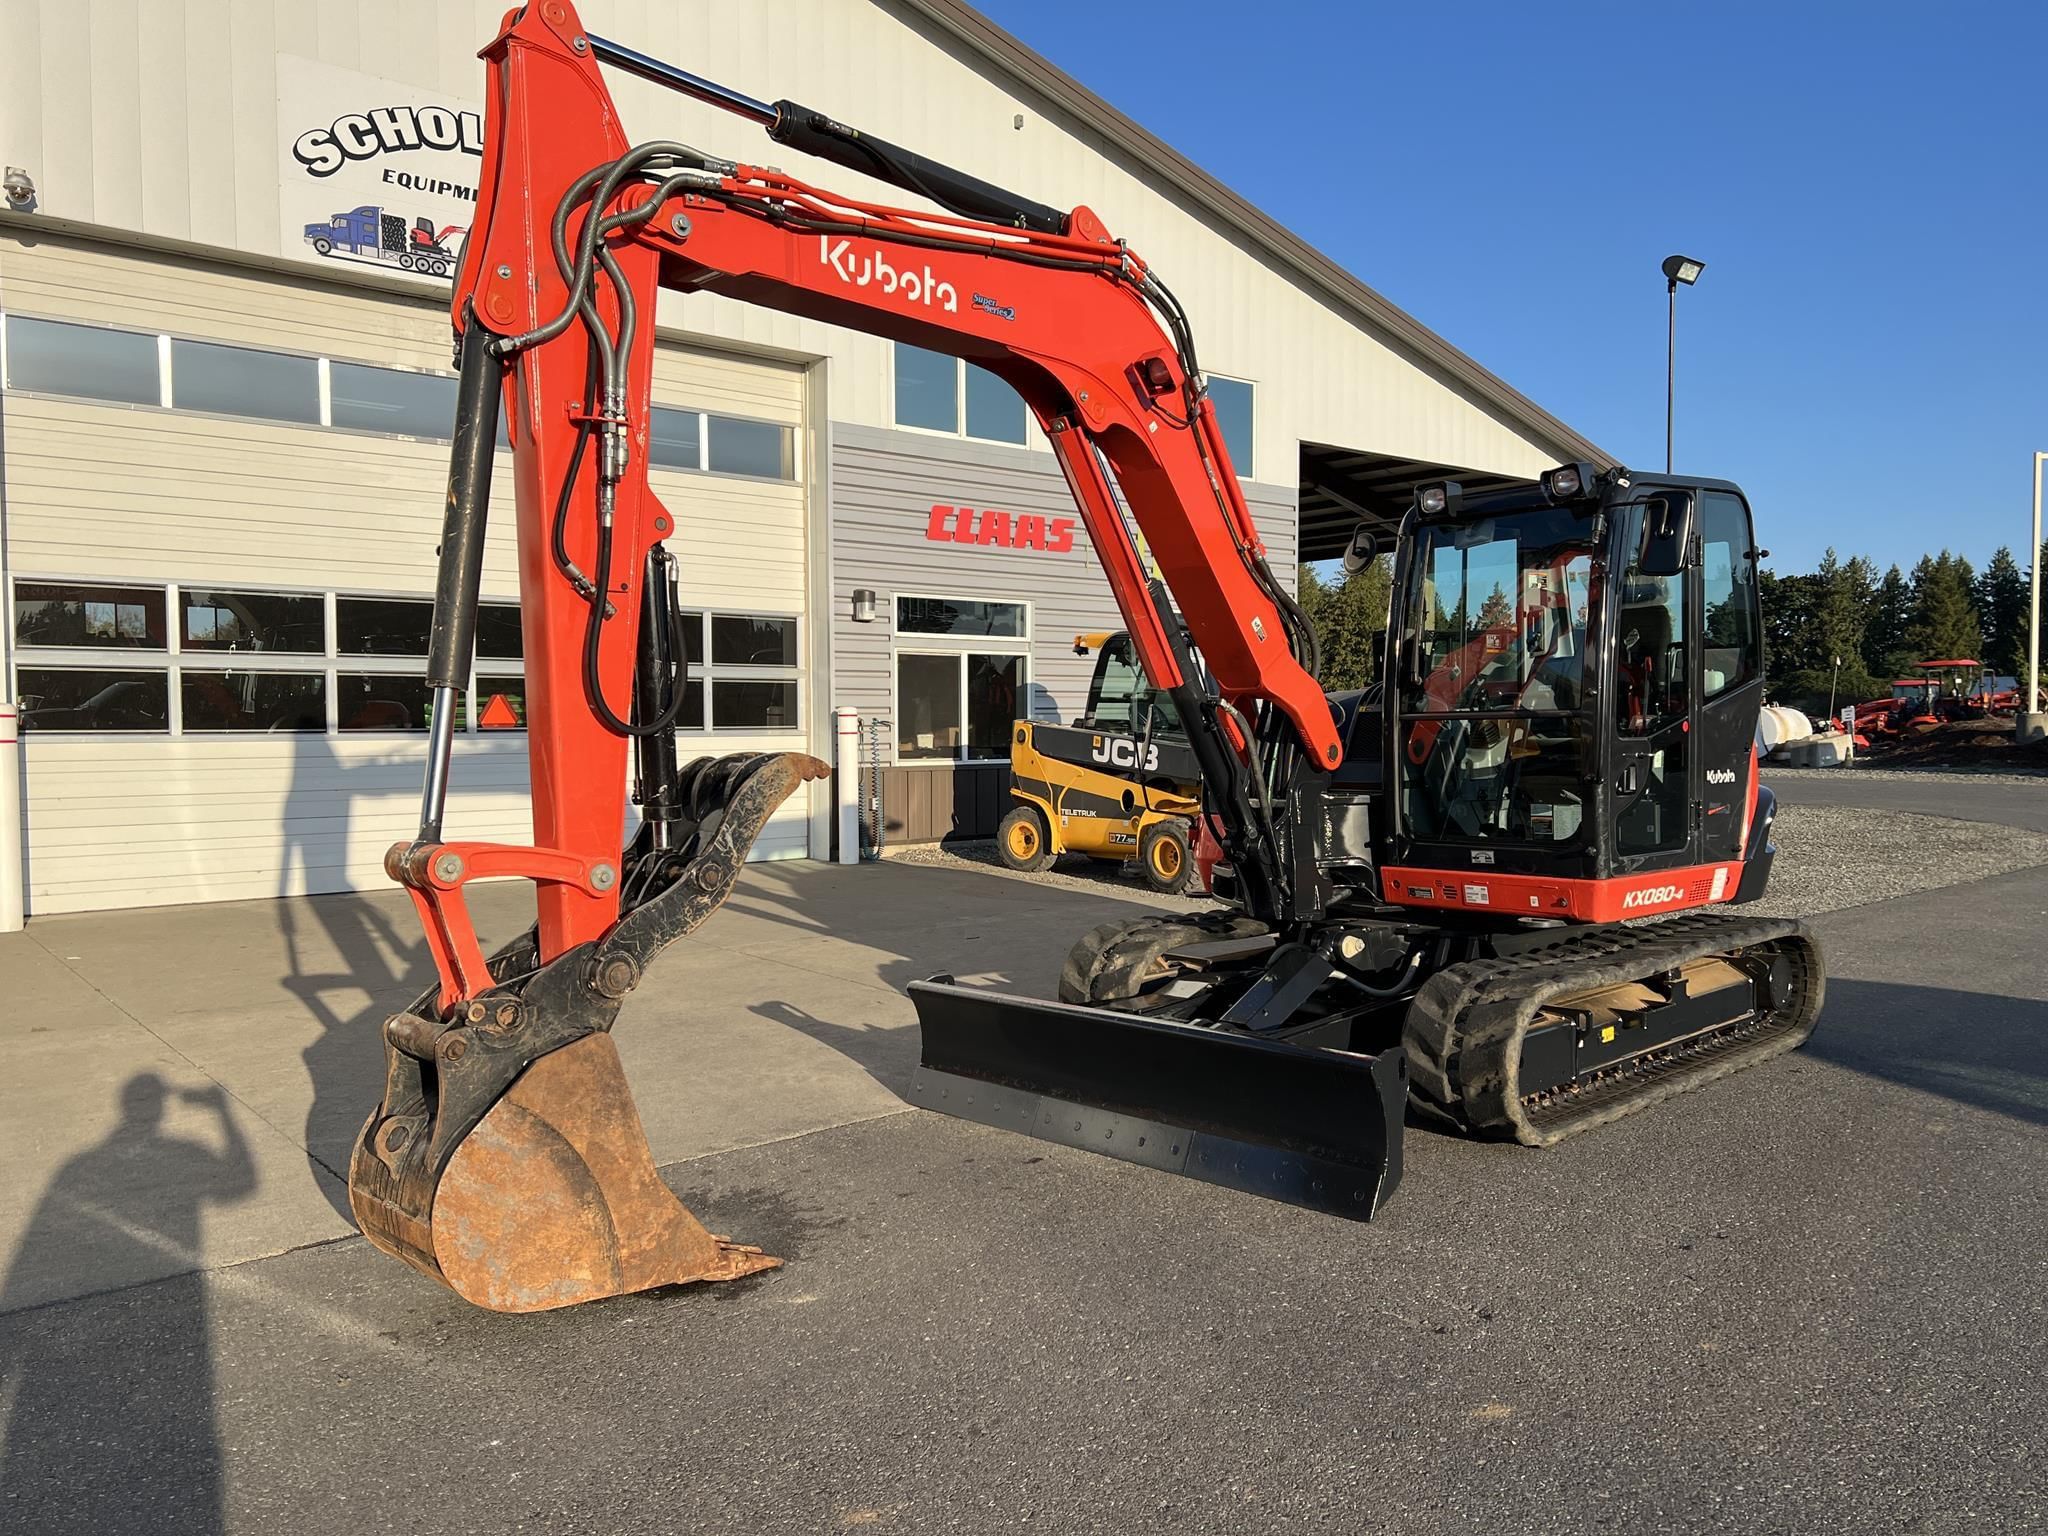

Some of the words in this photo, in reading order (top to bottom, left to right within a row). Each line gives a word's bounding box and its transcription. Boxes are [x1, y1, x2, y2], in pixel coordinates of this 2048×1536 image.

[820, 234, 957, 313] Kubota
[974, 294, 996, 306] Super
[927, 505, 1075, 552] CLAAS
[1092, 737, 1159, 771] JCB
[1706, 768, 1736, 784] Kubota
